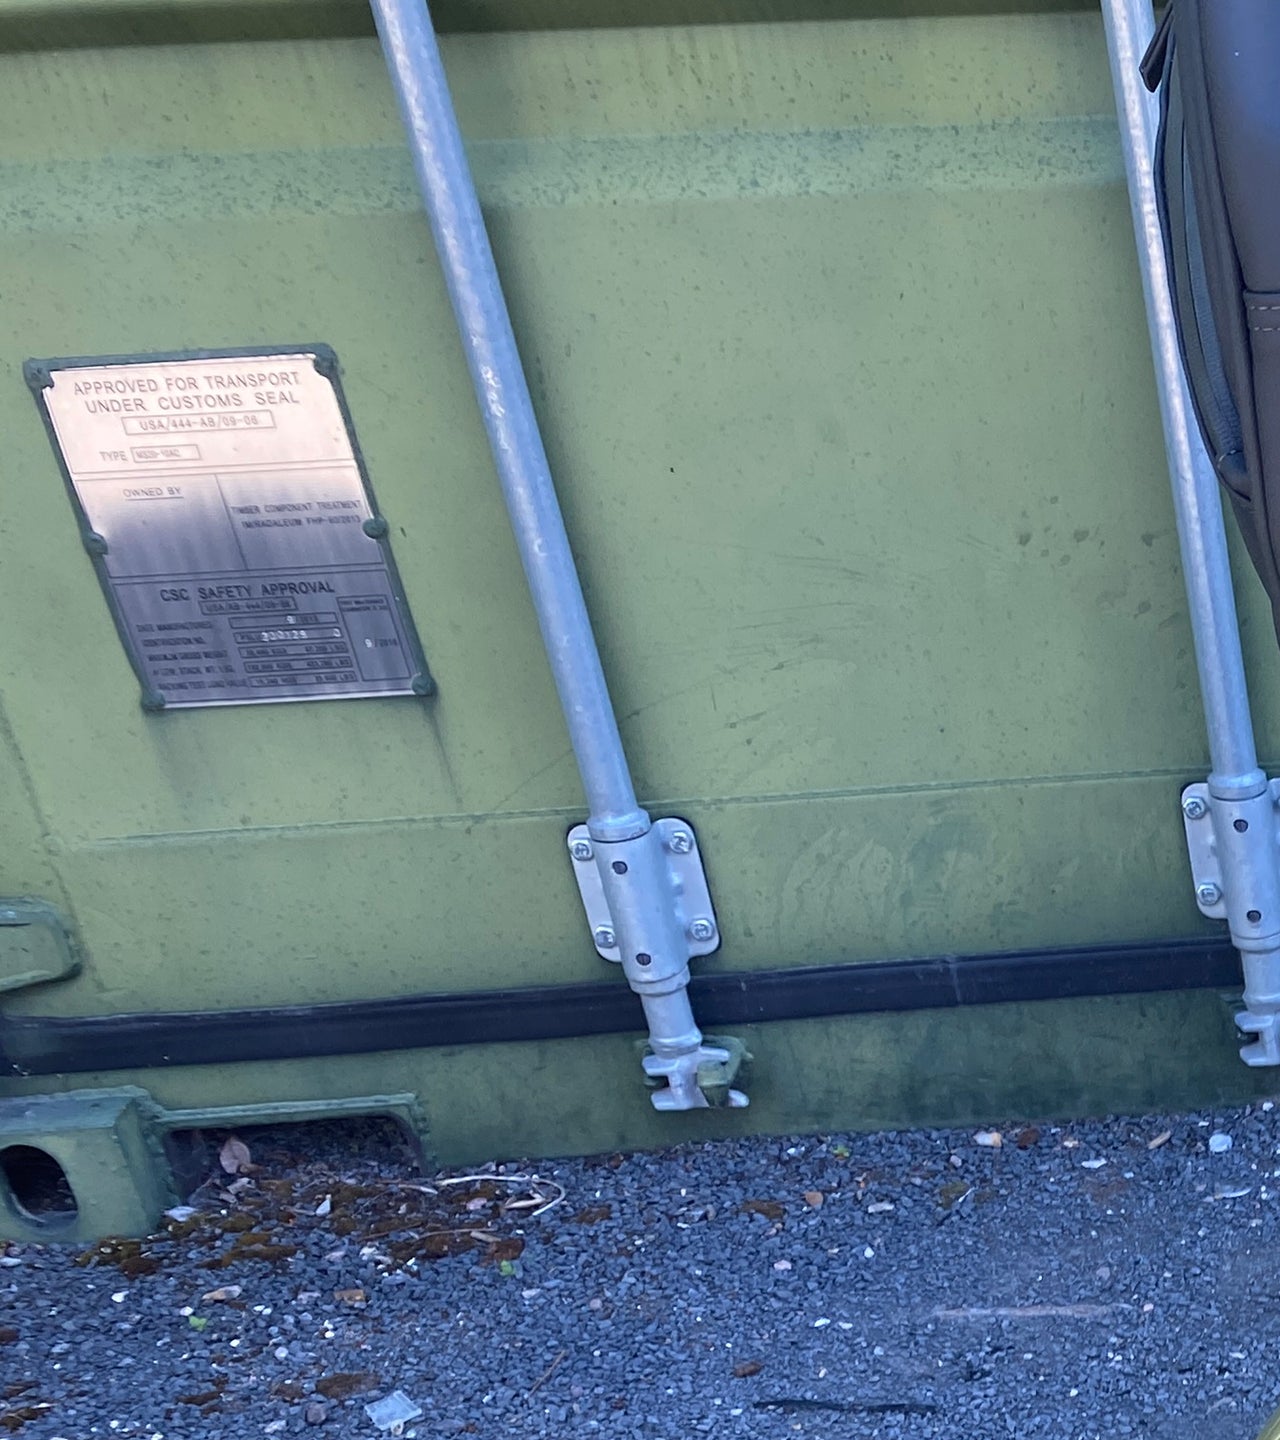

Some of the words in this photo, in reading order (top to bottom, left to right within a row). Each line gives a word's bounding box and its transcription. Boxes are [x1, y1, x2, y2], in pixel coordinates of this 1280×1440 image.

[72, 378, 158, 396] APPROVED
[165, 376, 198, 391] FOR
[204, 372, 300, 389] TRANSPORT
[86, 399, 146, 413] UNDER
[158, 393, 242, 410] CUSTOMS
[254, 390, 299, 405] SEAL
[100, 450, 126, 462] TYPE
[123, 487, 162, 497] OWNED
[167, 486, 181, 495] BY
[160, 588, 189, 601] CSC
[198, 585, 252, 598] SAFETY
[261, 581, 334, 596] APPROVAL
